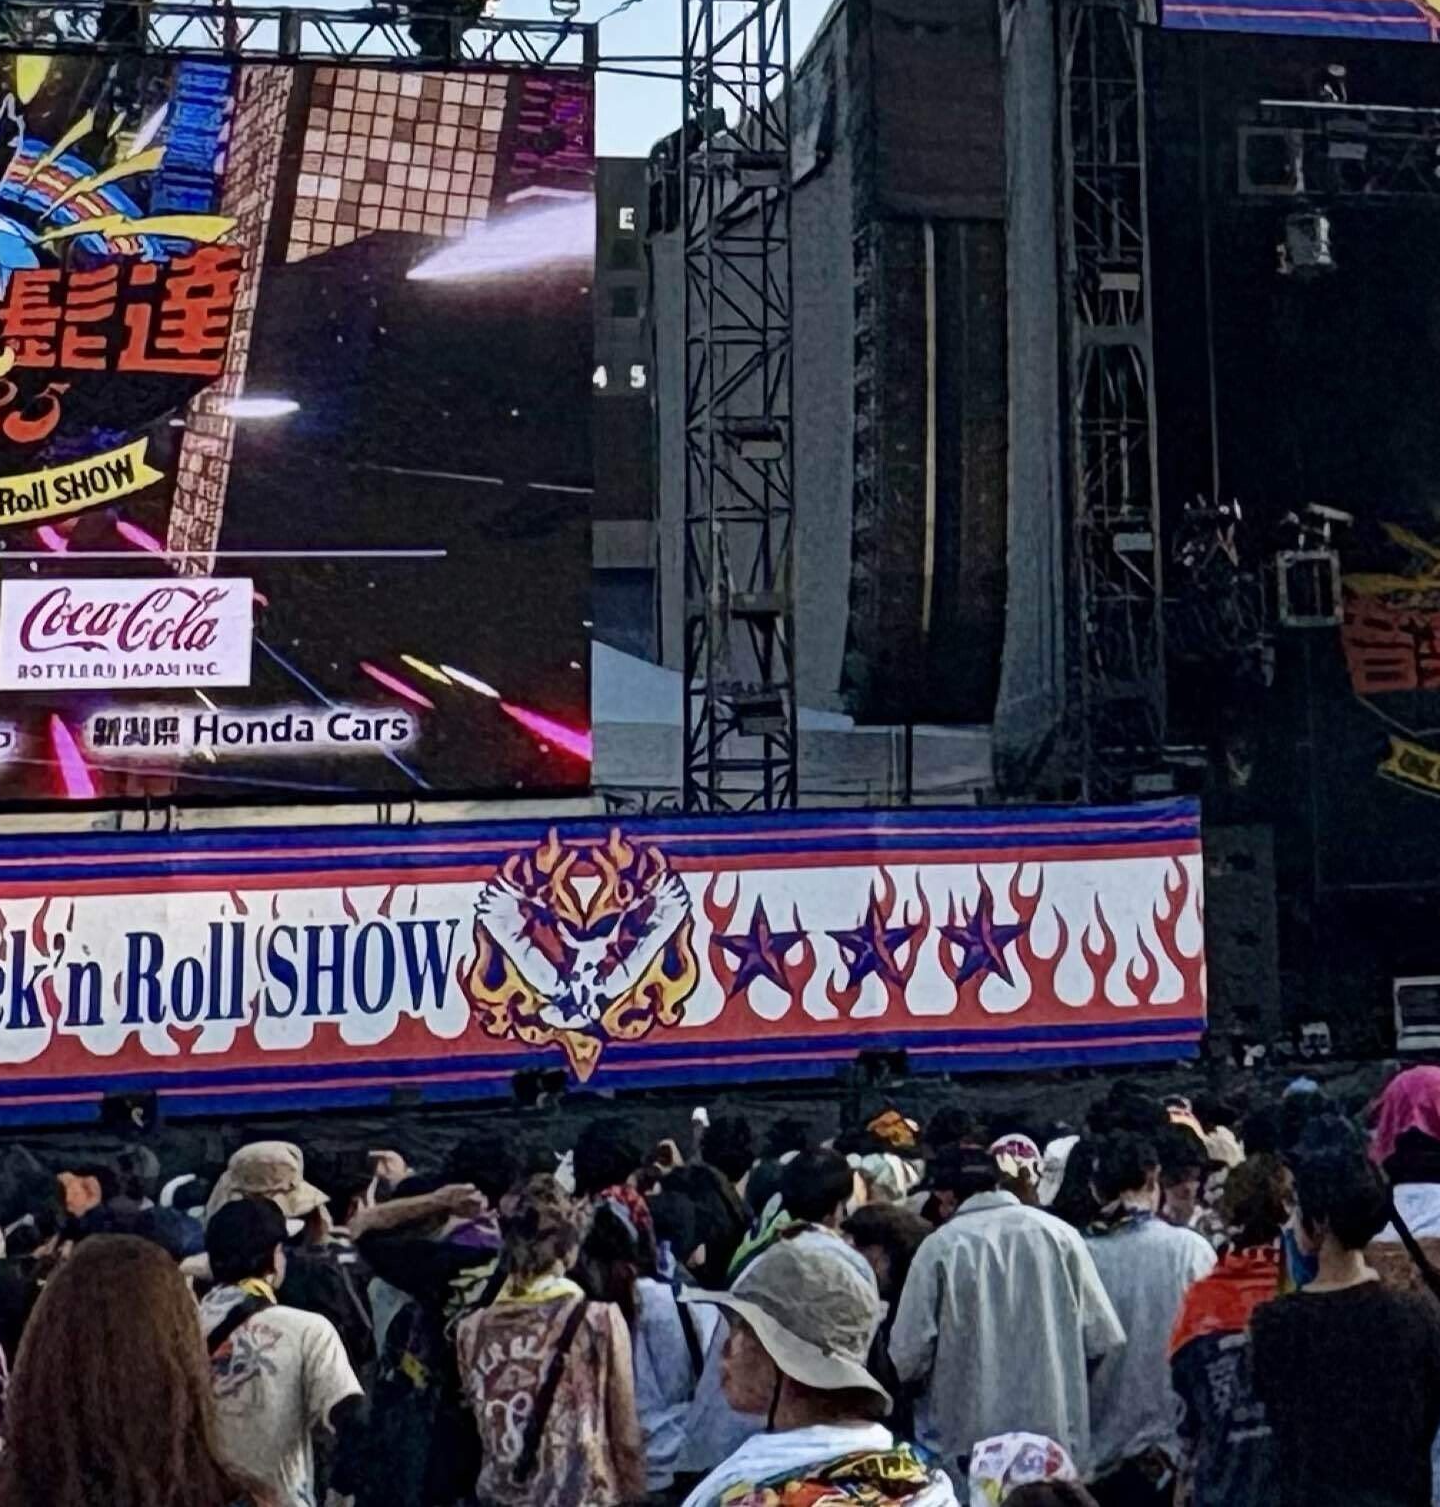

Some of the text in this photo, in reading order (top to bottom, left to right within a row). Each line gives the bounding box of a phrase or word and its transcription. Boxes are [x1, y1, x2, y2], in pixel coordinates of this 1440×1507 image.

[619, 207, 636, 232] E
[629, 363, 647, 389] 5
[52, 453, 137, 508] SHOW
[20, 586, 232, 653] Coca-Cola
[193, 712, 314, 746] Honda
[326, 712, 410, 742] Cars
[121, 921, 246, 1026] Roll
[257, 916, 464, 1022] SHOW
